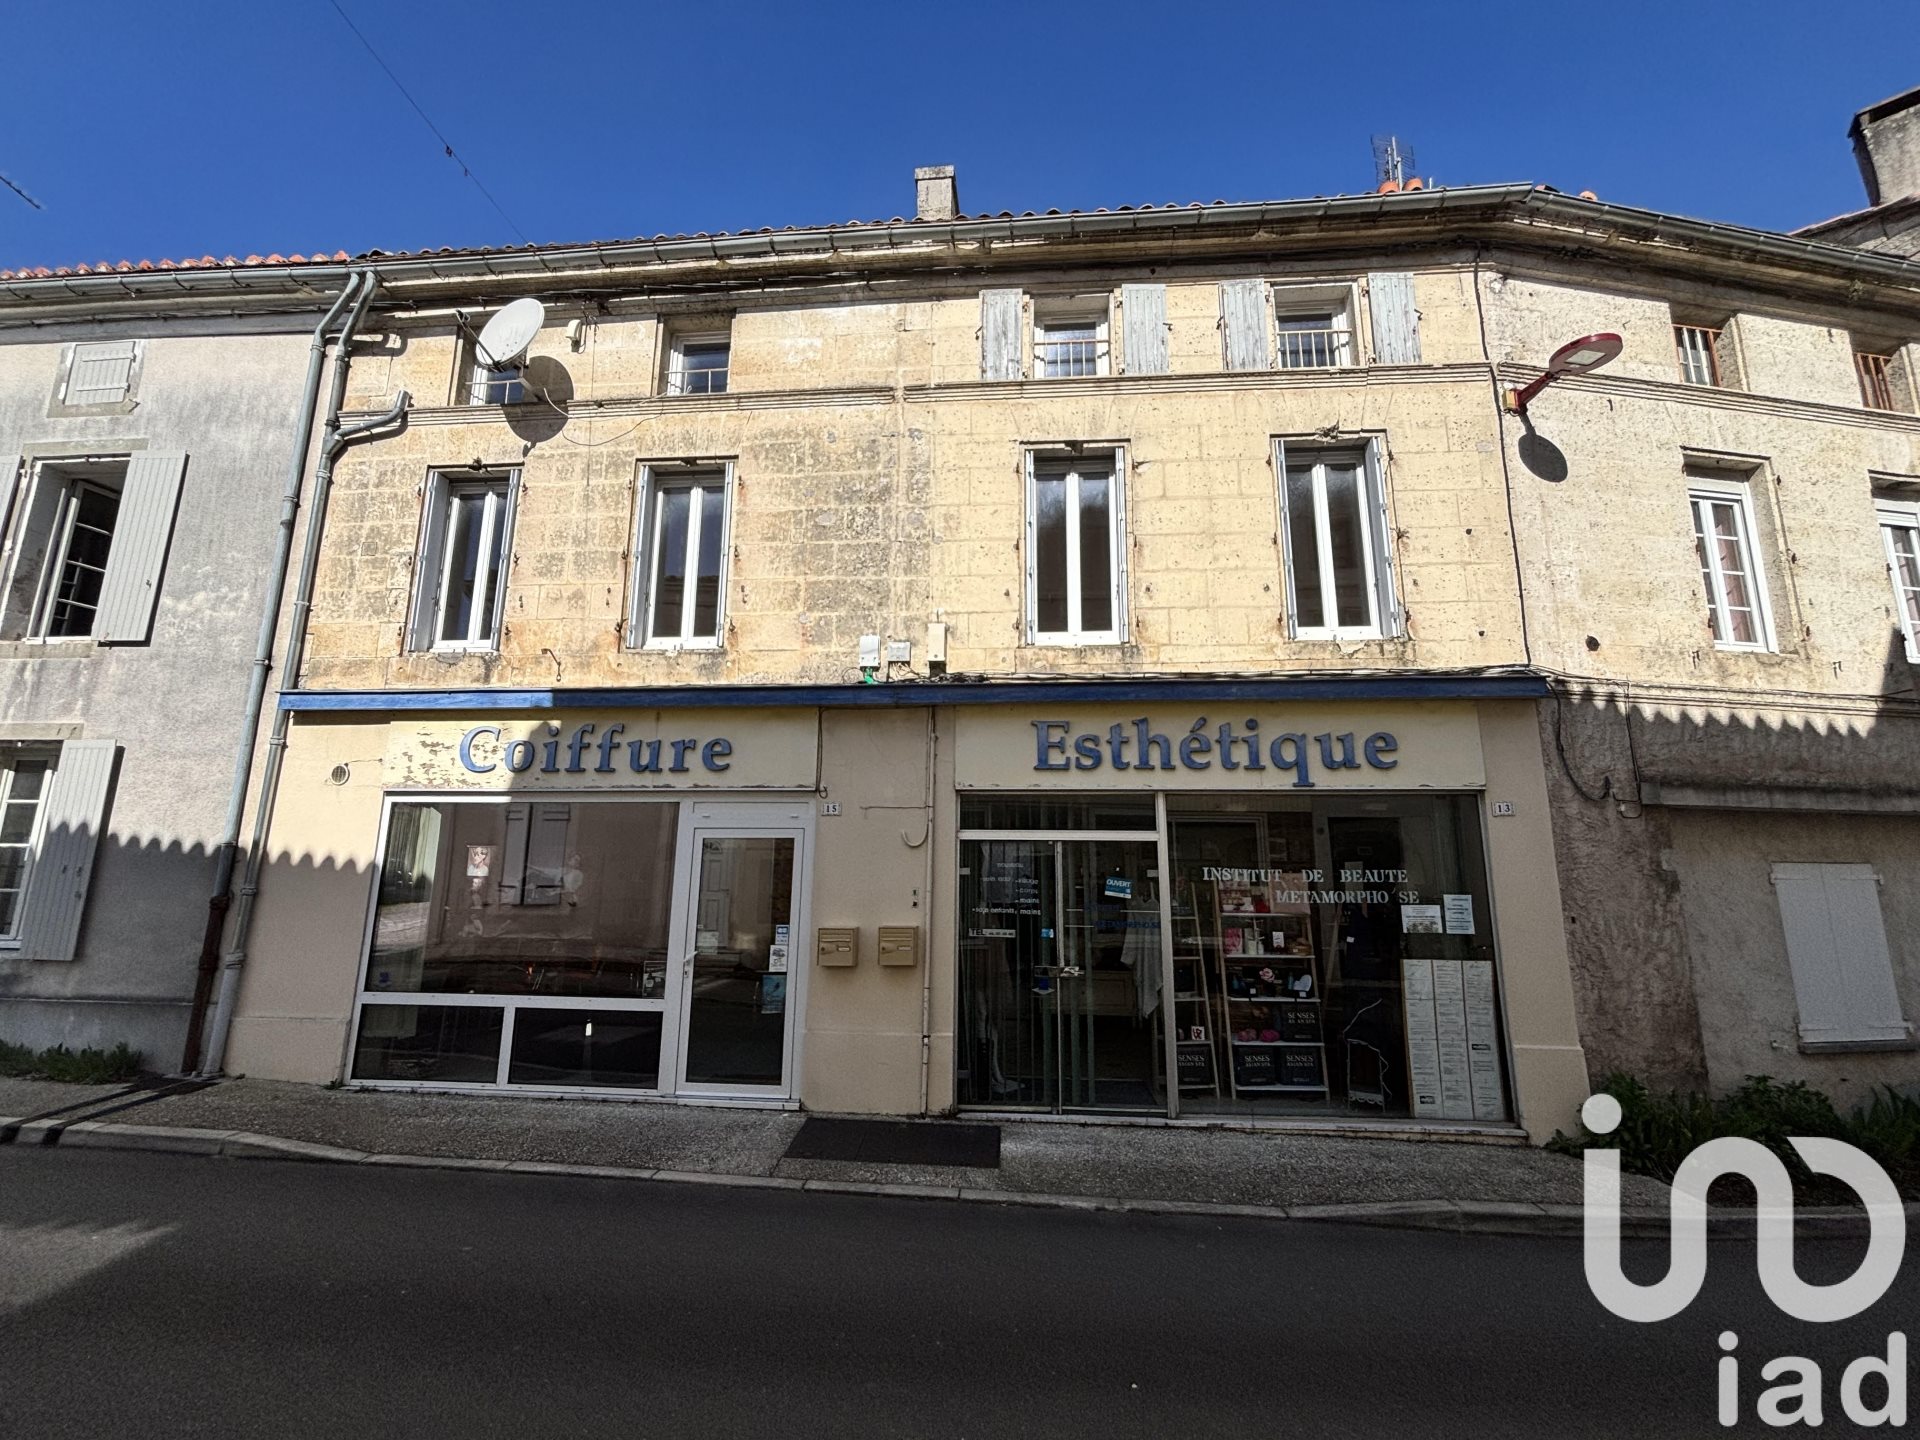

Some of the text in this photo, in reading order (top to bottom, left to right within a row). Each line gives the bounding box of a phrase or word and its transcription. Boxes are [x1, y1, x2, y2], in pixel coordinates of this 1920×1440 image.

[459, 723, 732, 773] Coiffure
[1031, 717, 1398, 787] Esthétique
[825, 805, 837, 813] 15
[1498, 804, 1510, 813] 13
[1202, 867, 1408, 882] INSTITUT DE BEAUTE
[1106, 879, 1131, 888] OUVERT
